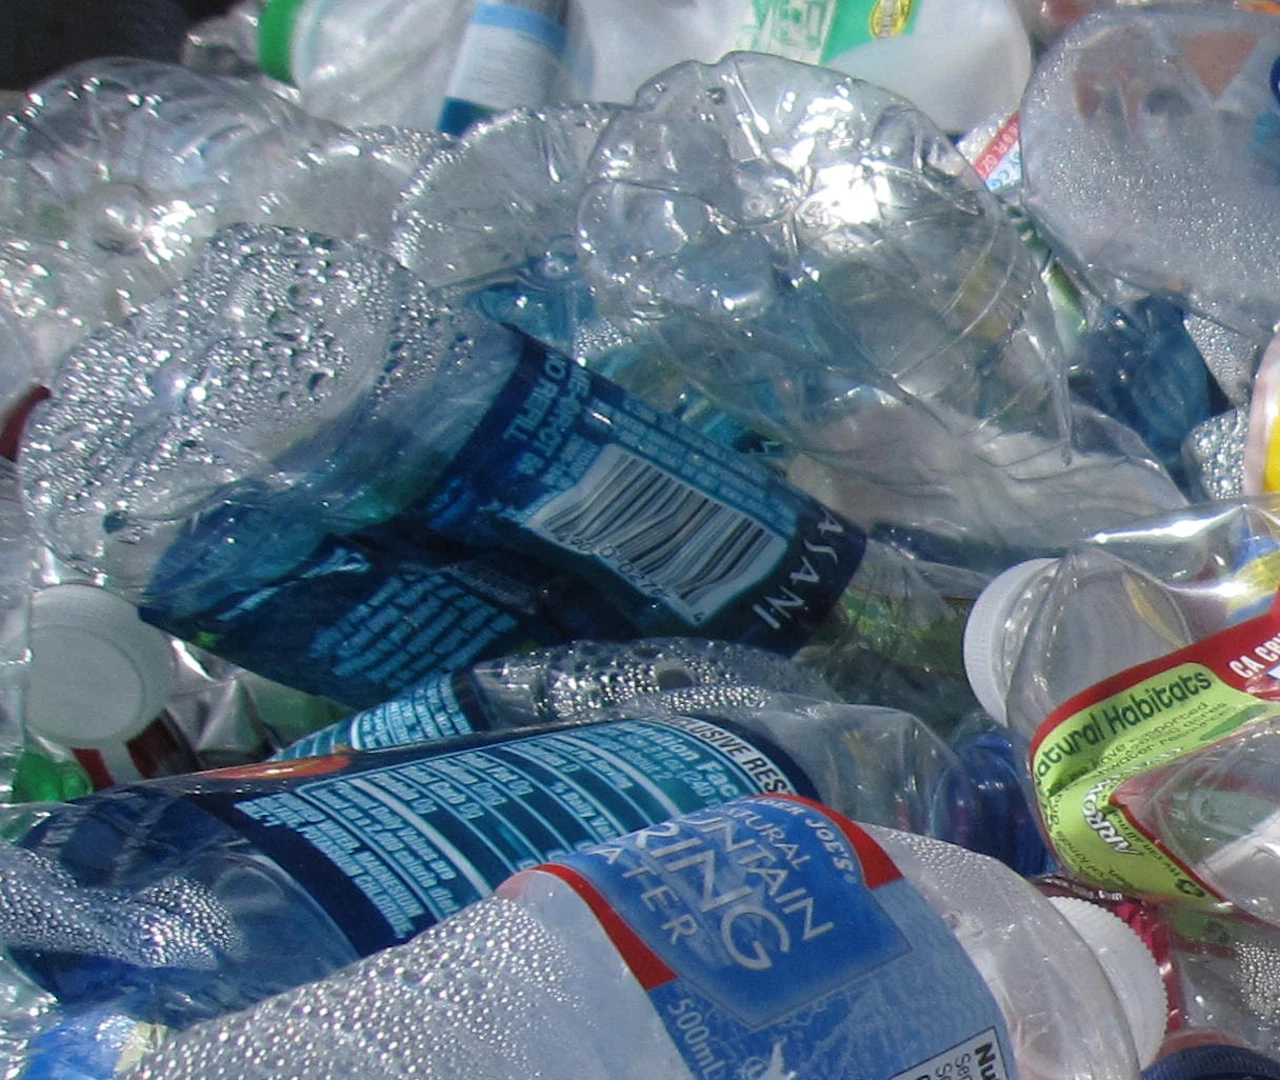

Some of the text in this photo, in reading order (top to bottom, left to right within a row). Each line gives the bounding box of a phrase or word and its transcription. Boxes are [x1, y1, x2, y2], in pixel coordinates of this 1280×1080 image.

[502, 373, 560, 450] REFILL
[1100, 670, 1213, 736] Habitats
[1229, 654, 1263, 679] CA
[294, 819, 425, 944] POTASSIUM CHLORIDE
[804, 817, 854, 872] JOE'S
[345, 845, 434, 923] MAGNESIUM
[668, 999, 726, 1080] 500mL
